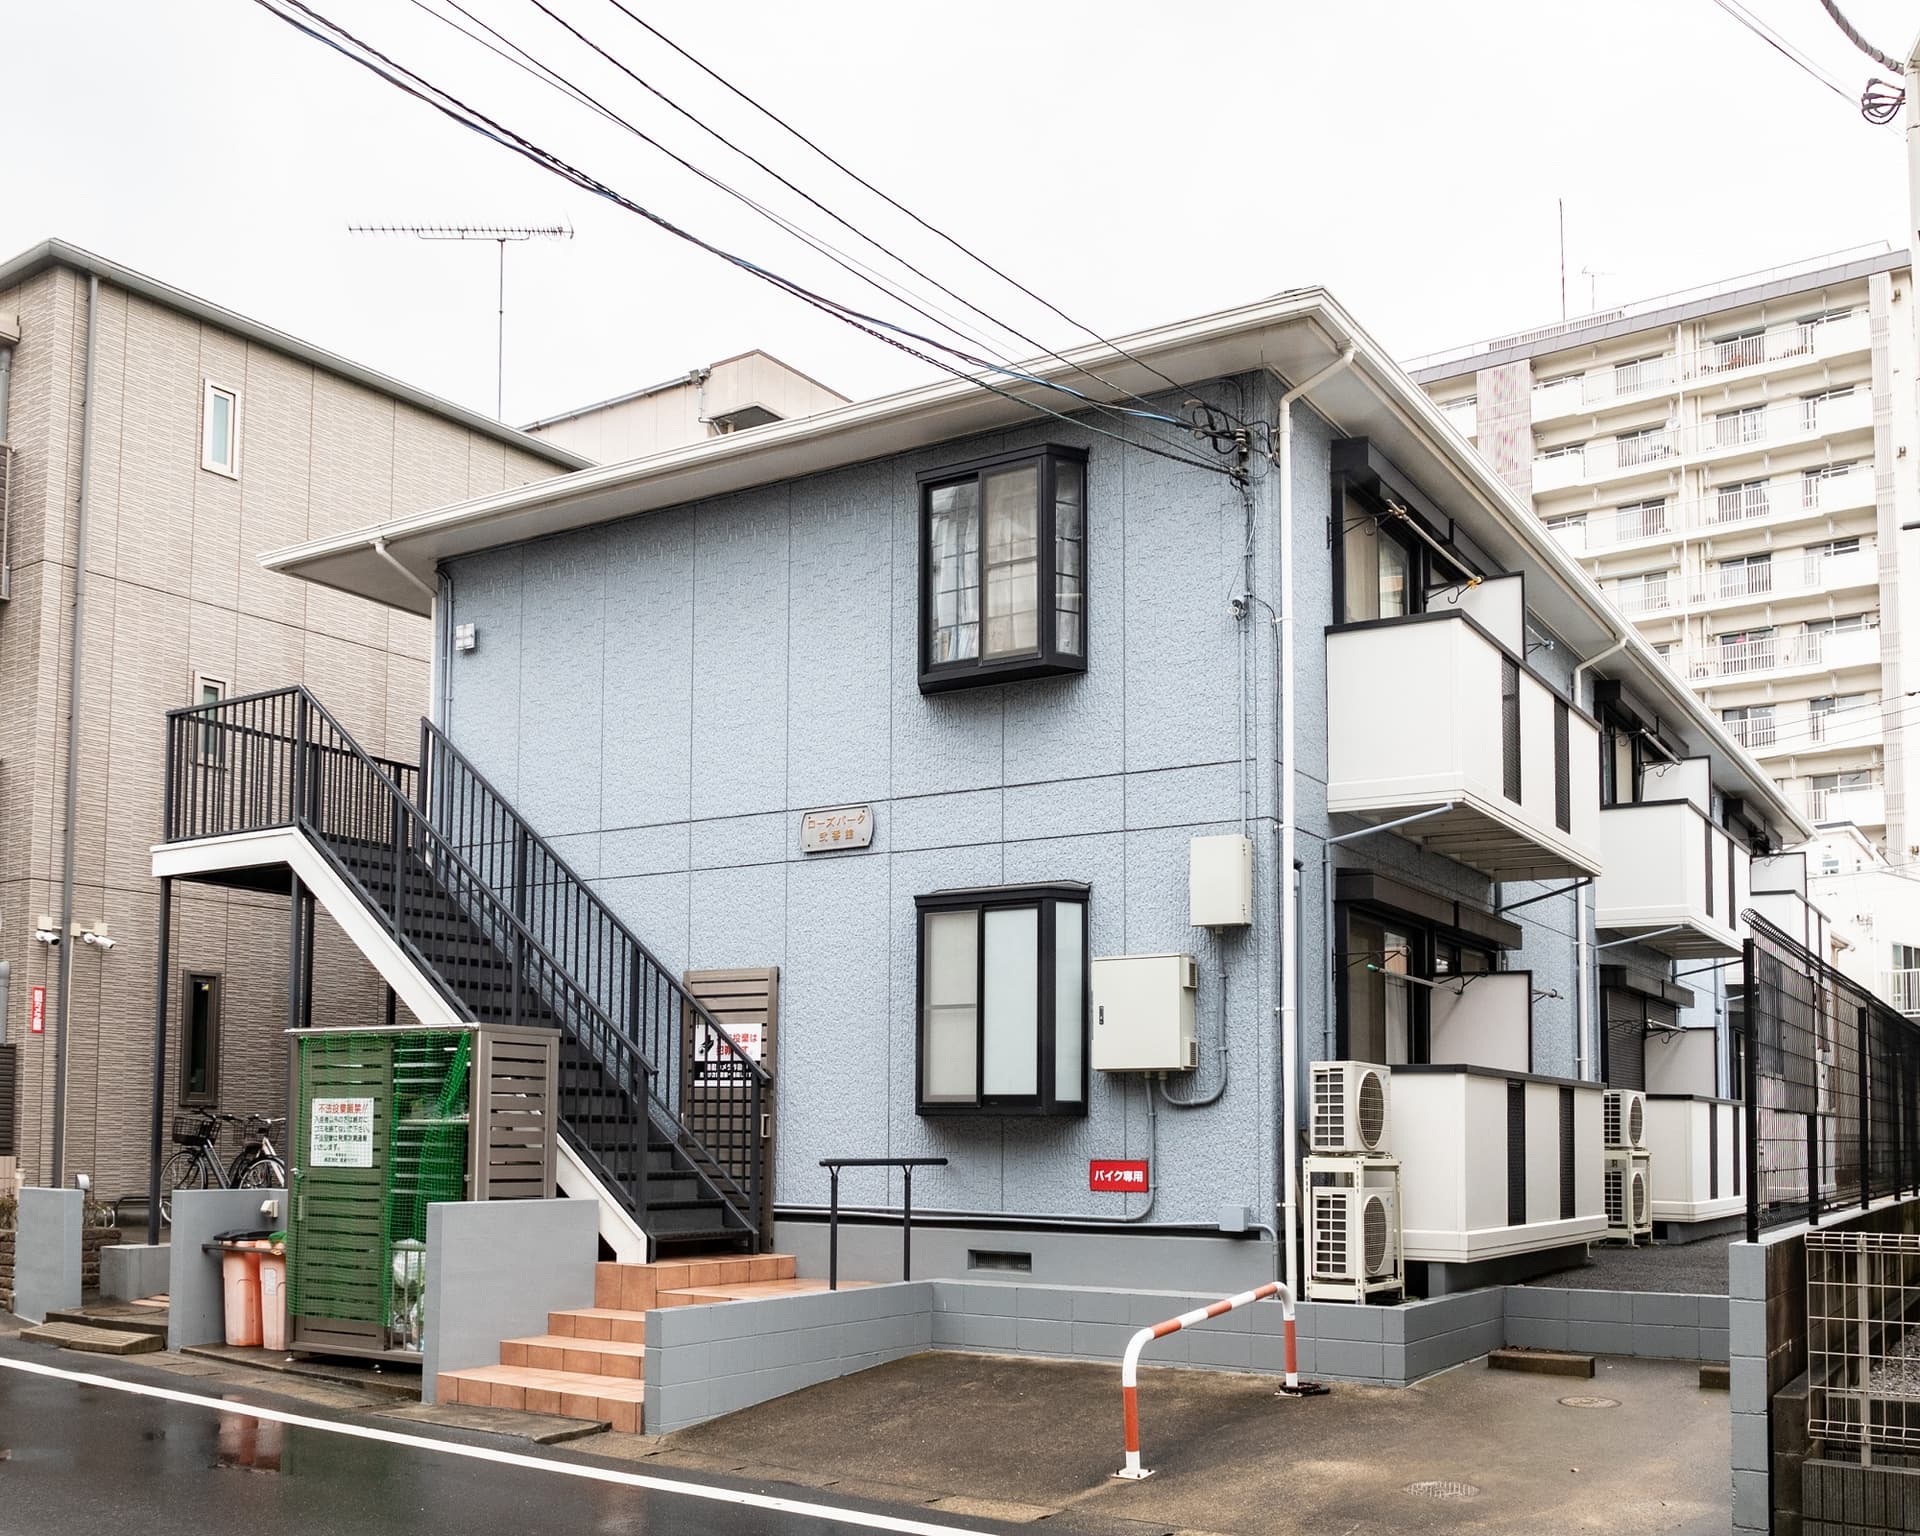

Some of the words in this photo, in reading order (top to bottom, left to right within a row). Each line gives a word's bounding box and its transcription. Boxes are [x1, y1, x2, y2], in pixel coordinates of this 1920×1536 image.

[1094, 1170, 1143, 1182] バイク専用
